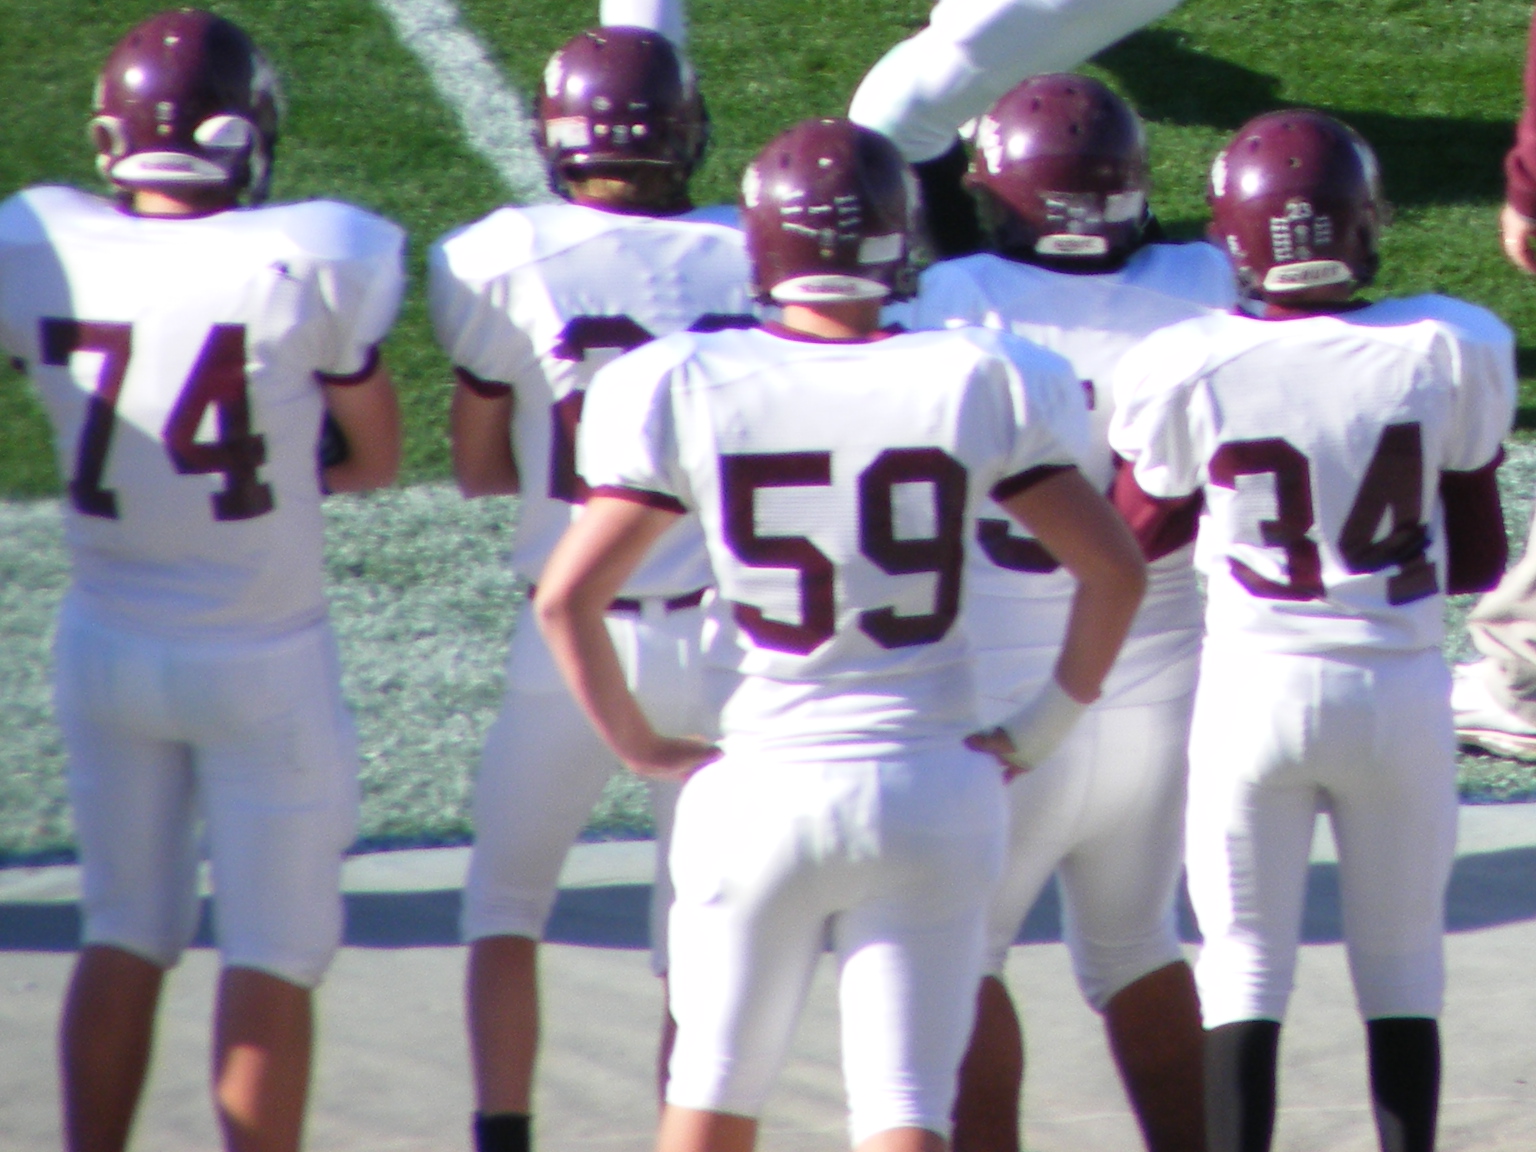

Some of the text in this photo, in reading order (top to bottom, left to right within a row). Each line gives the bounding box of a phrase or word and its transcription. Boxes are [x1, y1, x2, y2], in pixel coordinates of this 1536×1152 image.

[37, 315, 277, 522] 74
[1208, 420, 1440, 607] 34
[718, 446, 968, 658] 59
